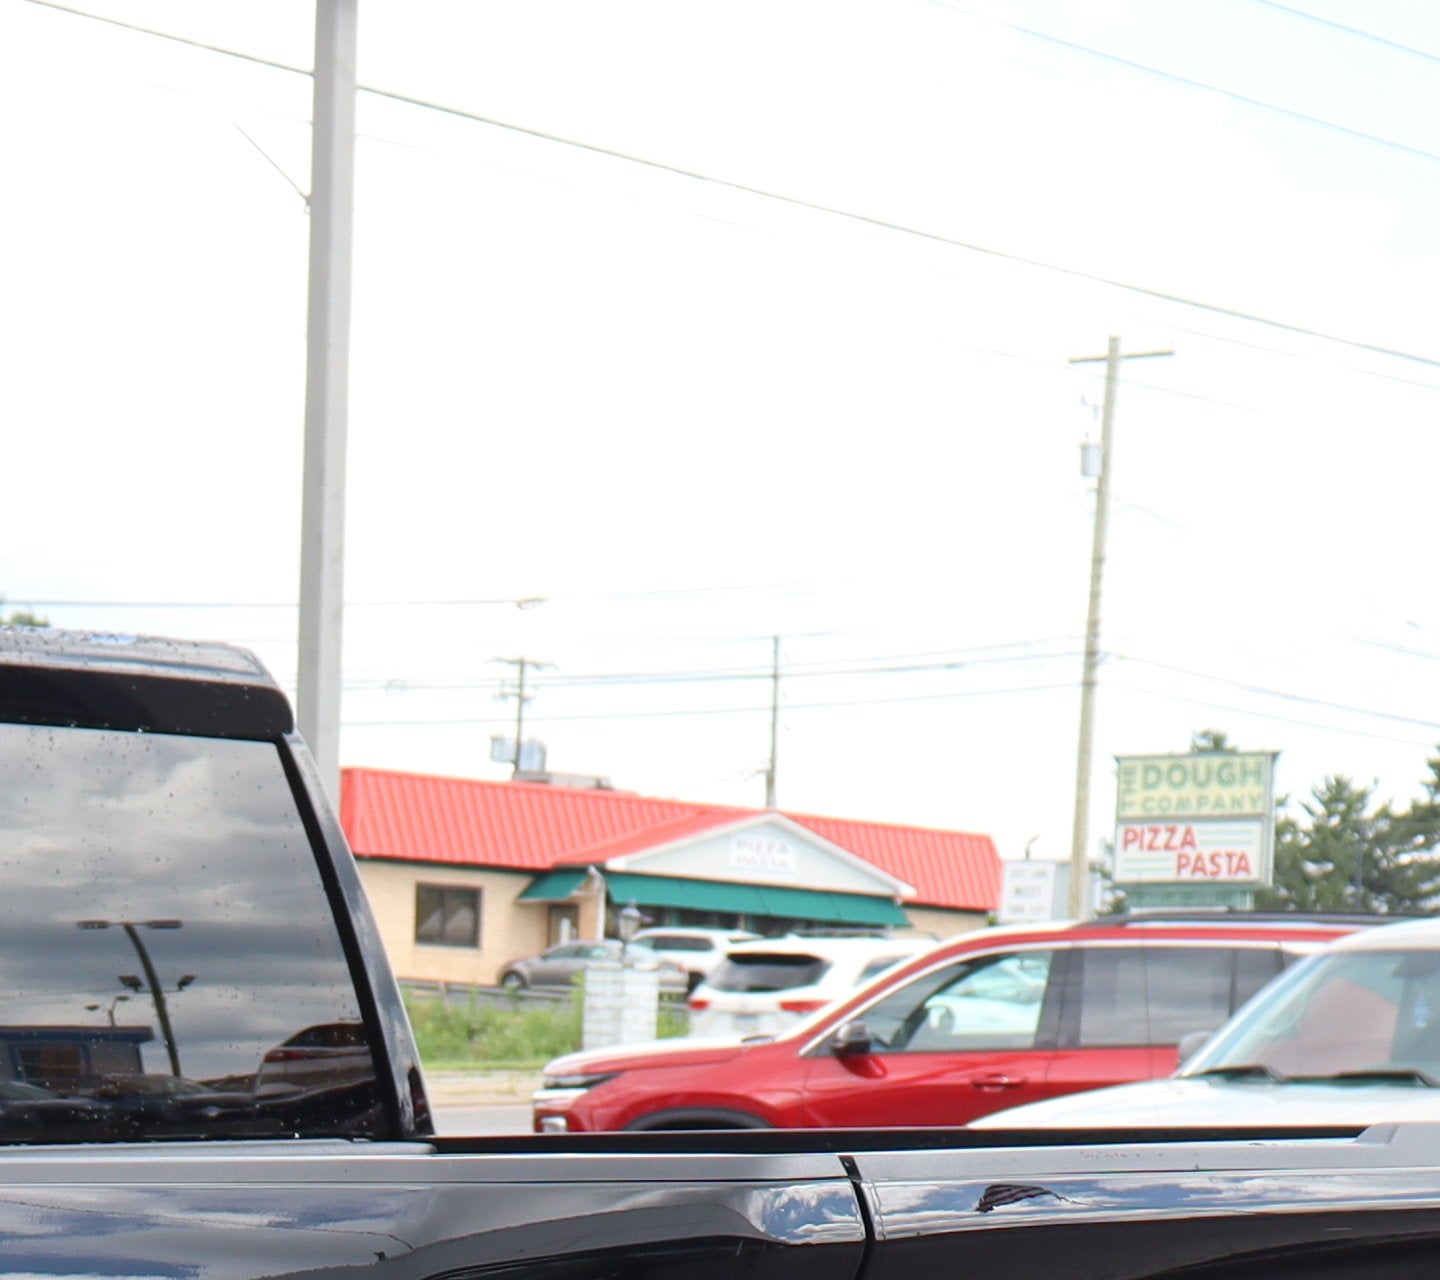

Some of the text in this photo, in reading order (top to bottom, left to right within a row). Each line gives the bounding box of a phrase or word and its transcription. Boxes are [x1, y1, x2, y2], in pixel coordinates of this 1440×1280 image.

[1142, 761, 1263, 790] DOUGH
[1141, 794, 1261, 812] COMPANY
[1123, 825, 1197, 851] PIZZA
[1176, 851, 1252, 877] PASTA
